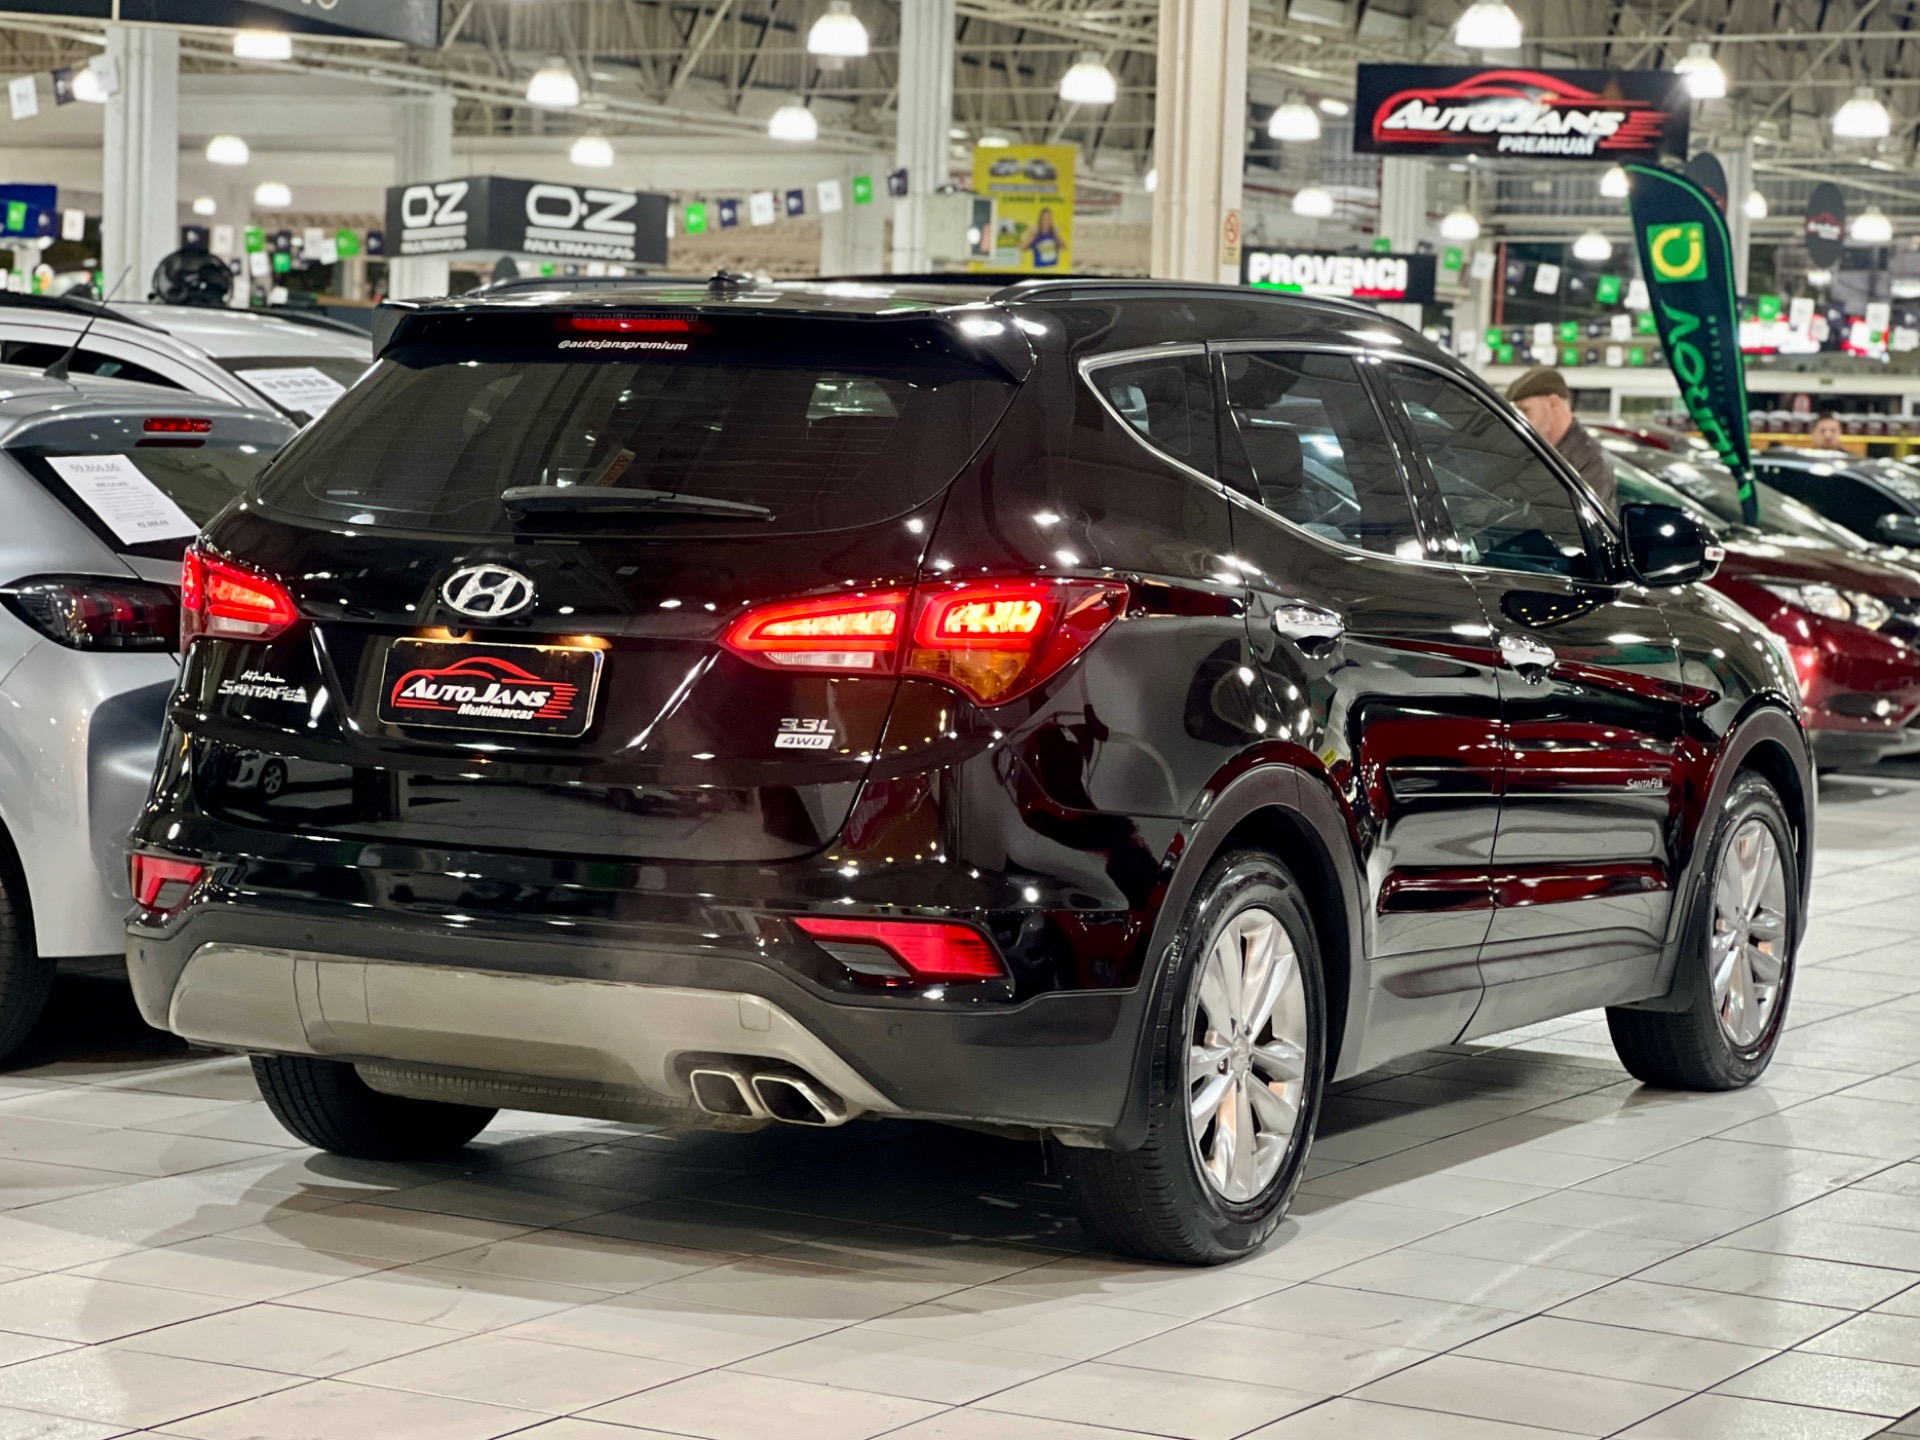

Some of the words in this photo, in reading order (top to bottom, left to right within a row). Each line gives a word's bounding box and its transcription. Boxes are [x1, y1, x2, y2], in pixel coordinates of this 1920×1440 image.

[1497, 134, 1597, 155] PREMIUM
[1248, 252, 1408, 292] PROVENCI
[558, 339, 688, 351] @autojanspremium
[457, 703, 534, 720] Multimarcas
[782, 736, 825, 747] 4WD
